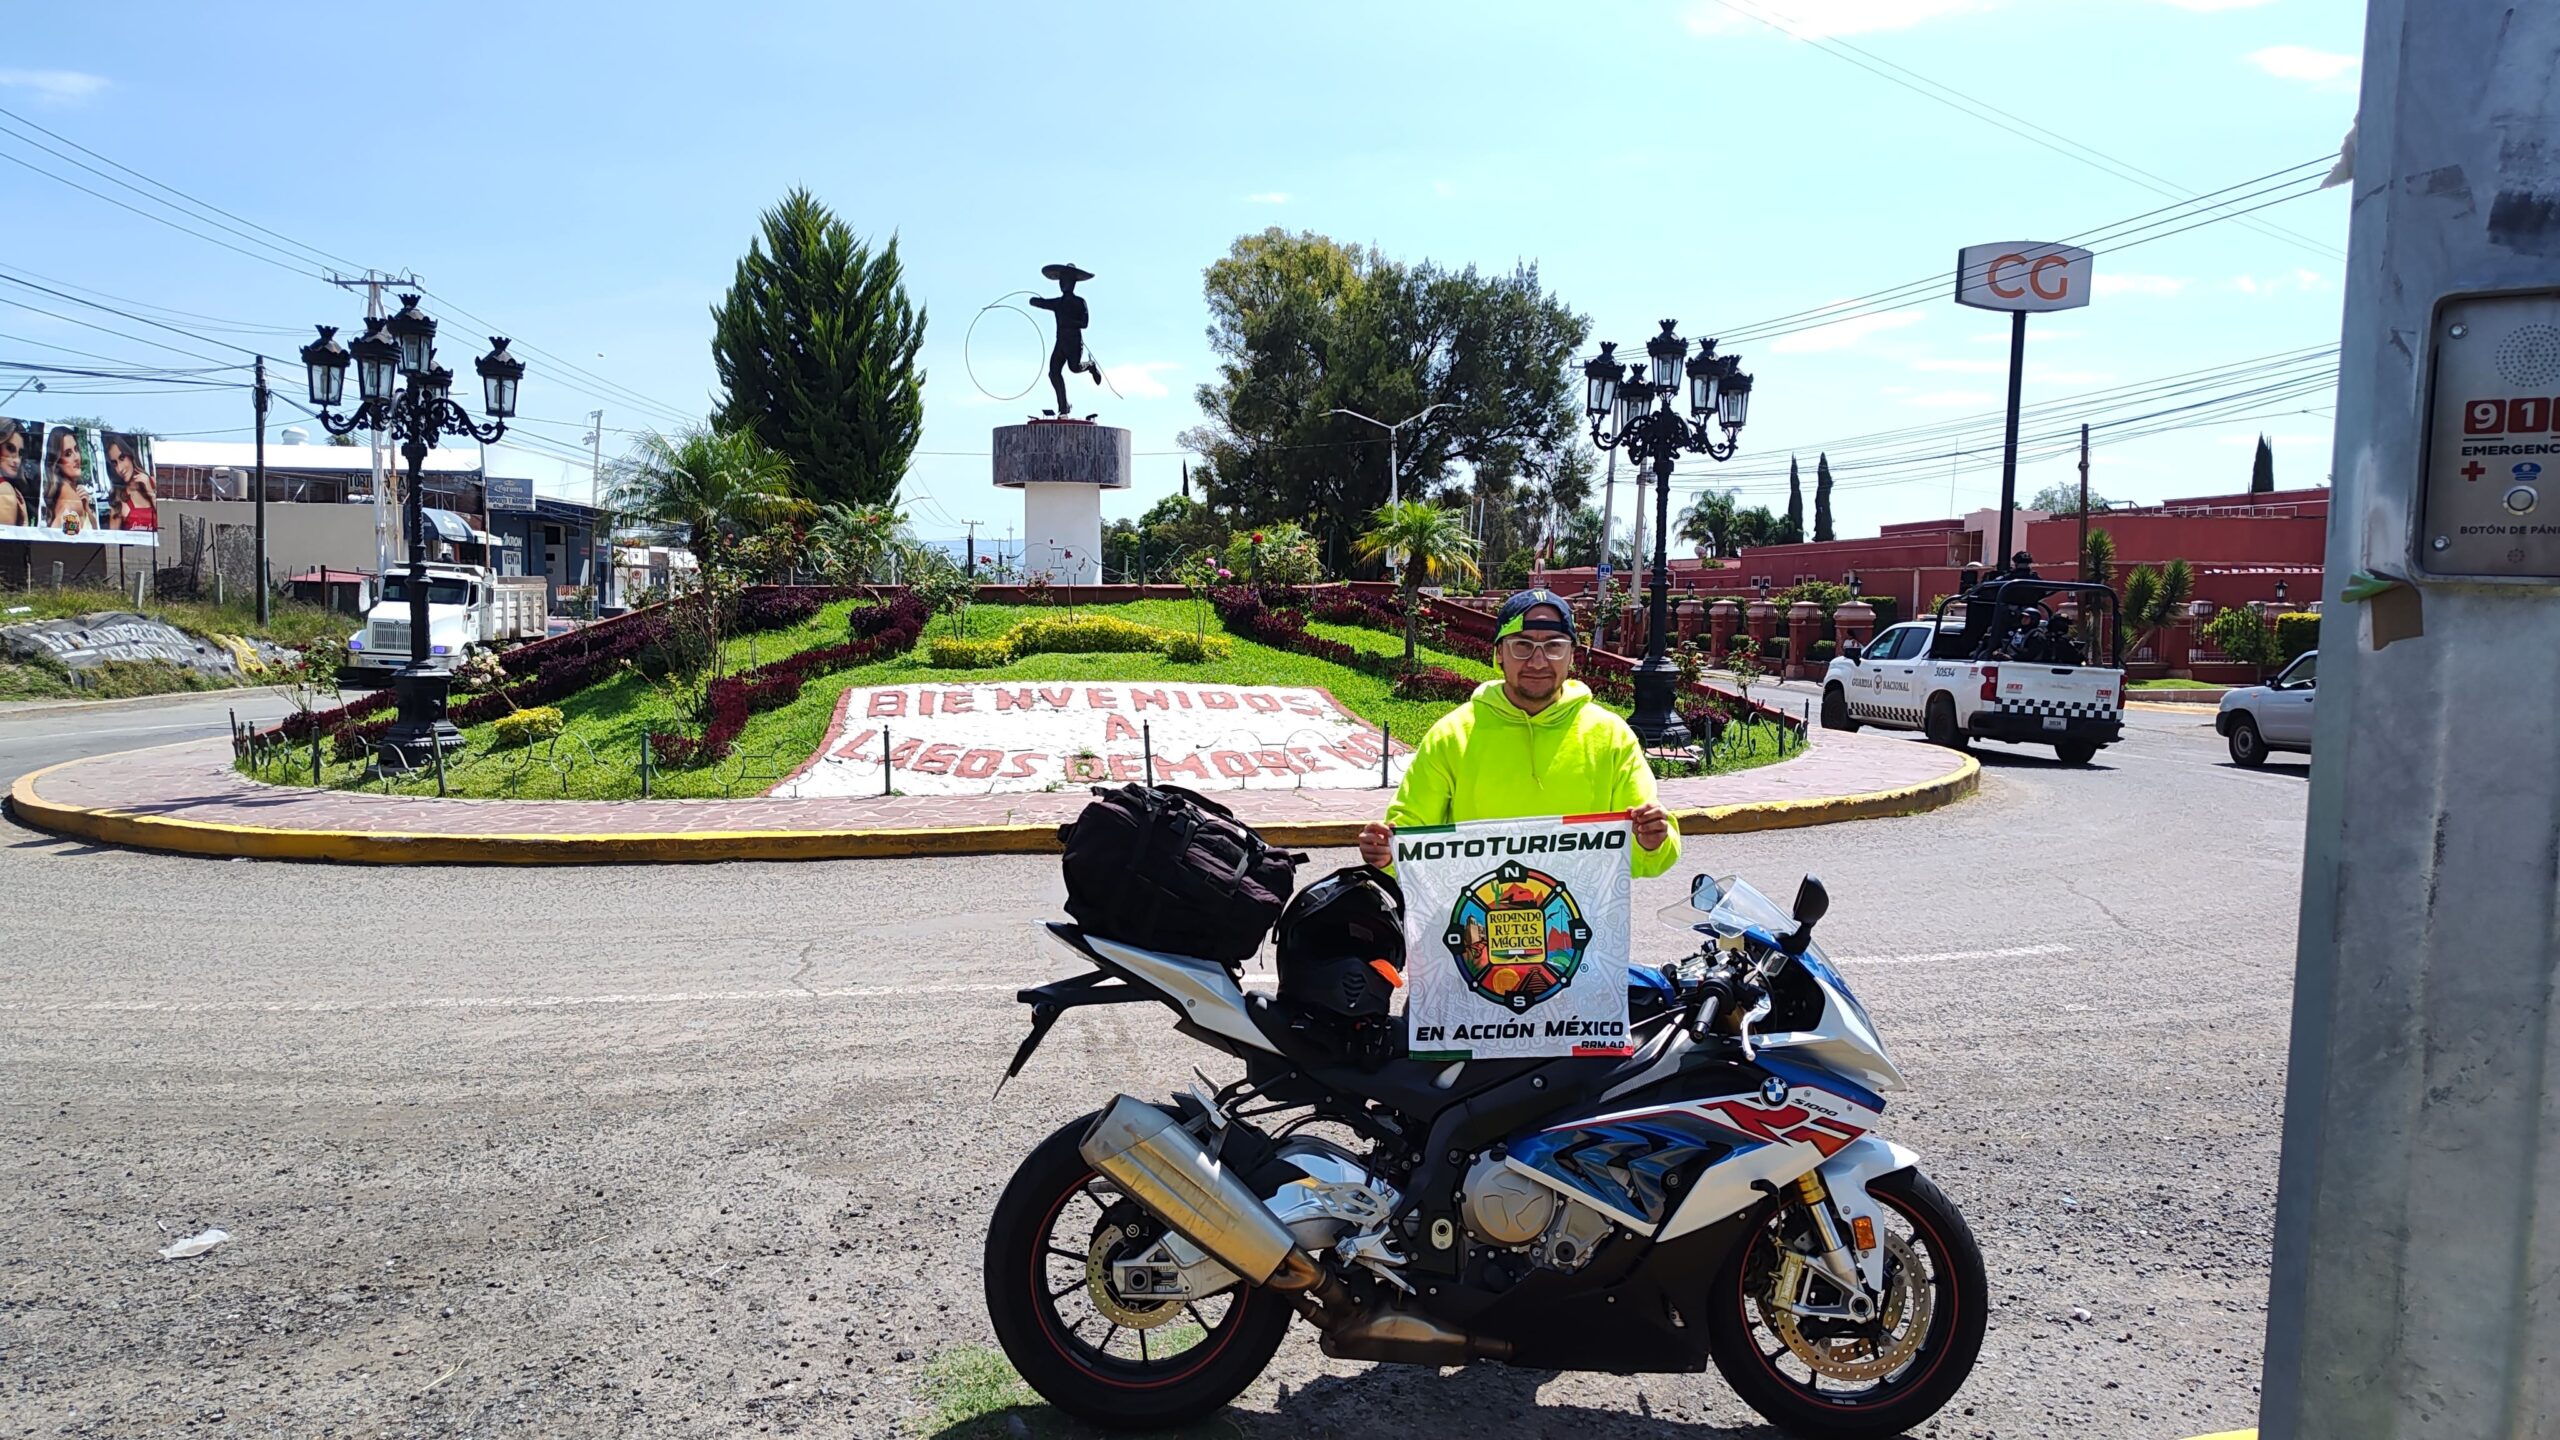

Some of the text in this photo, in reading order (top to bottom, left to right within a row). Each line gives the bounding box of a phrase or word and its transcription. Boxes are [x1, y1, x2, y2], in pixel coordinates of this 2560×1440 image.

[1987, 253, 2069, 300] CG
[2461, 443, 2560, 456] EMERGENC
[2460, 524, 2506, 535] BOTÓN
[2509, 526, 2528, 535] DE
[504, 553, 520, 565] VENTA
[1852, 678, 1910, 691] GUARDIA NACIONAL
[867, 686, 1322, 718] BIENVENIDOS
[1104, 713, 1140, 742] A
[833, 729, 1412, 783] LAGOS DE MORENO
[1398, 830, 1627, 862] MOTOTURISMO
[1504, 867, 1520, 878] N
[1447, 933, 1461, 944] O
[1574, 928, 1587, 940] E
[1513, 996, 1526, 1007] S
[1416, 1016, 1624, 1041] EN ACCIÓN MÉXICO
